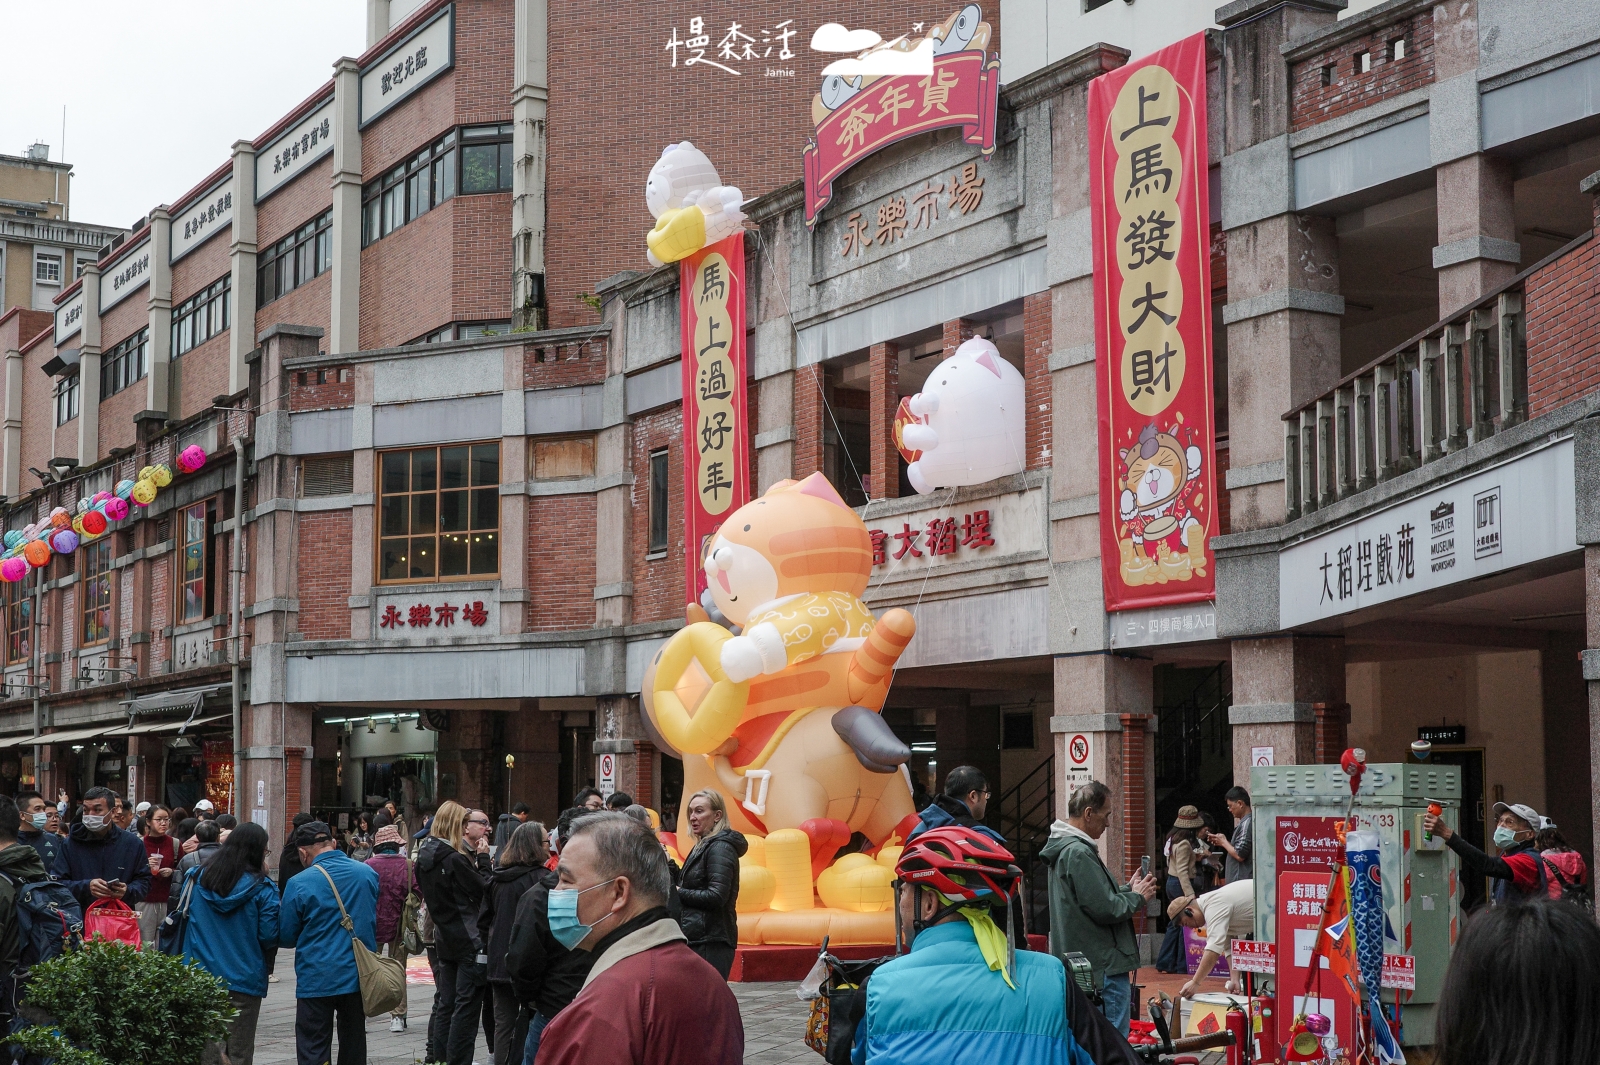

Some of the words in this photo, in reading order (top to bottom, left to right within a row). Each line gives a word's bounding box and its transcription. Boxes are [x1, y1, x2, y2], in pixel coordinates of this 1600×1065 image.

[381, 46, 428, 96] 歡迎光臨
[836, 67, 959, 158] 奔年貨
[841, 162, 985, 256] 永樂市場
[1119, 85, 1178, 401] 上馬發大財
[699, 261, 734, 502] 馬上過好年
[1430, 516, 1455, 535] THEATER
[1430, 537, 1455, 556] MUSEUM
[1319, 522, 1415, 606] 大稻埕戲苑
[1430, 557, 1456, 573] WORKSHOP
[380, 601, 488, 630] 永樂市場
[1127, 613, 1215, 636] 三、四樓商場入口
[1301, 837, 1341, 848] 台北年貨大
[1286, 900, 1325, 916] 表演節
